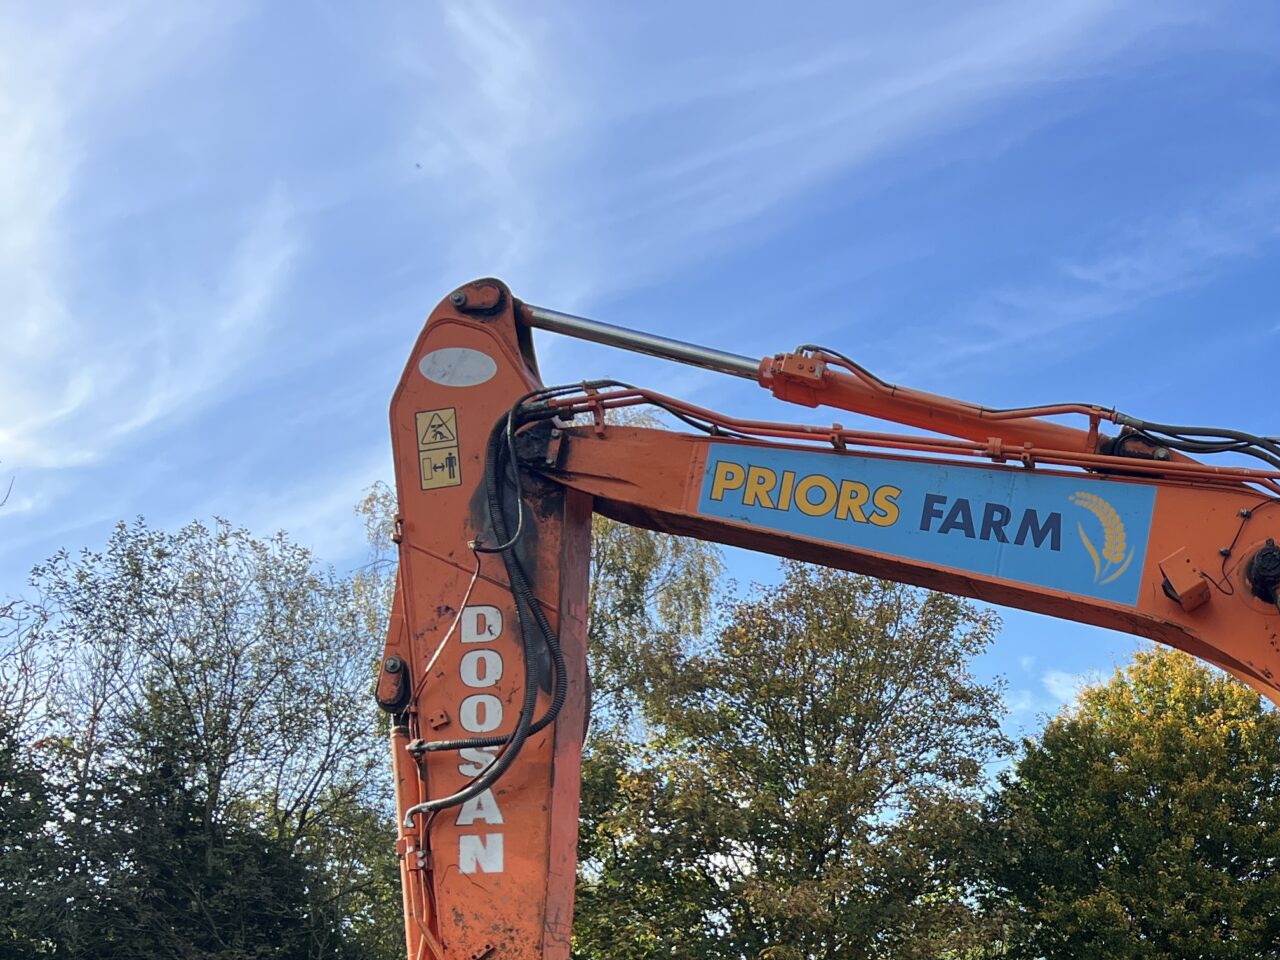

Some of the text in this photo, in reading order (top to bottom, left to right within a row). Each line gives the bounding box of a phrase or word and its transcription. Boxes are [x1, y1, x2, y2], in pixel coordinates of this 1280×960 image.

[710, 460, 1062, 552] PRIORS FARM
[455, 604, 504, 873] DOOSAN
